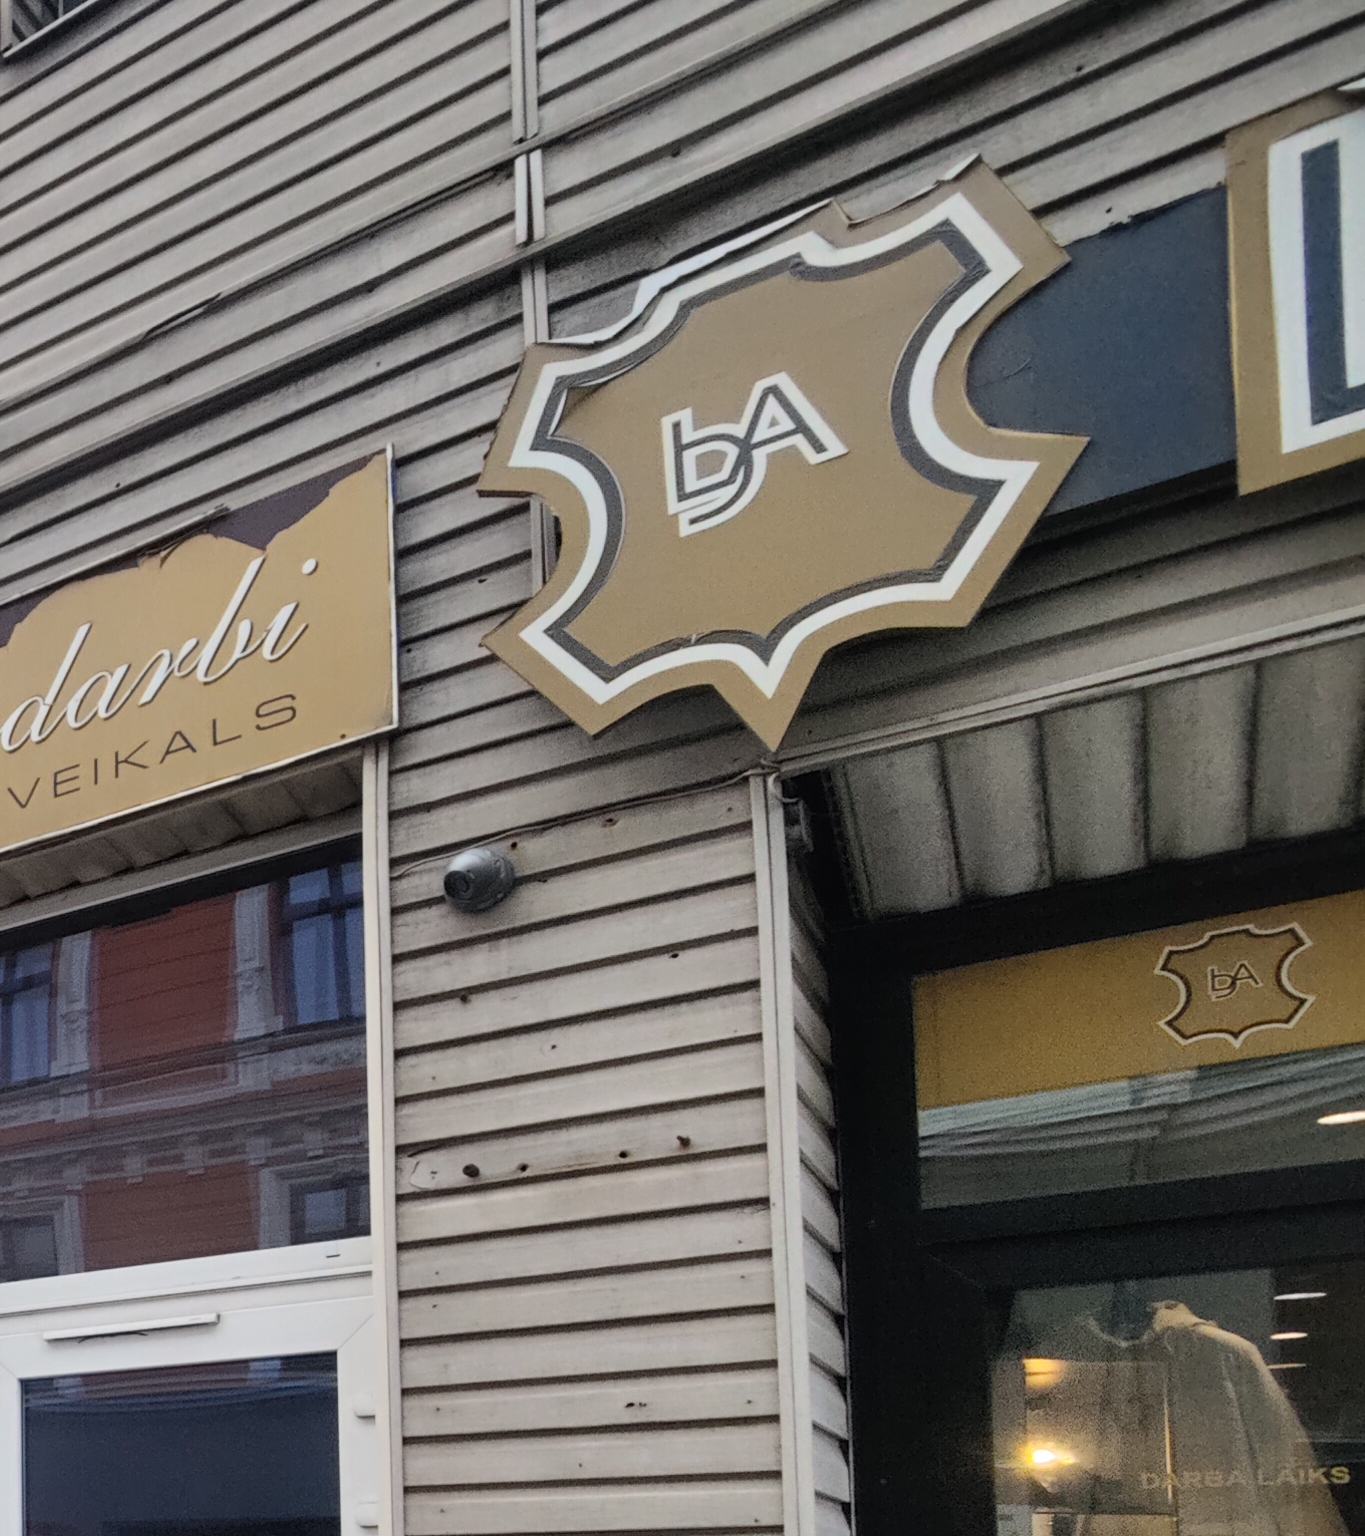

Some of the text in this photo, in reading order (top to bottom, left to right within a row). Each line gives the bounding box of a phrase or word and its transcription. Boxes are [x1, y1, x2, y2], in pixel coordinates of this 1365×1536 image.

[7, 693, 297, 809] VEIKALS
[1140, 1466, 1352, 1489] DARBA LAIKS
